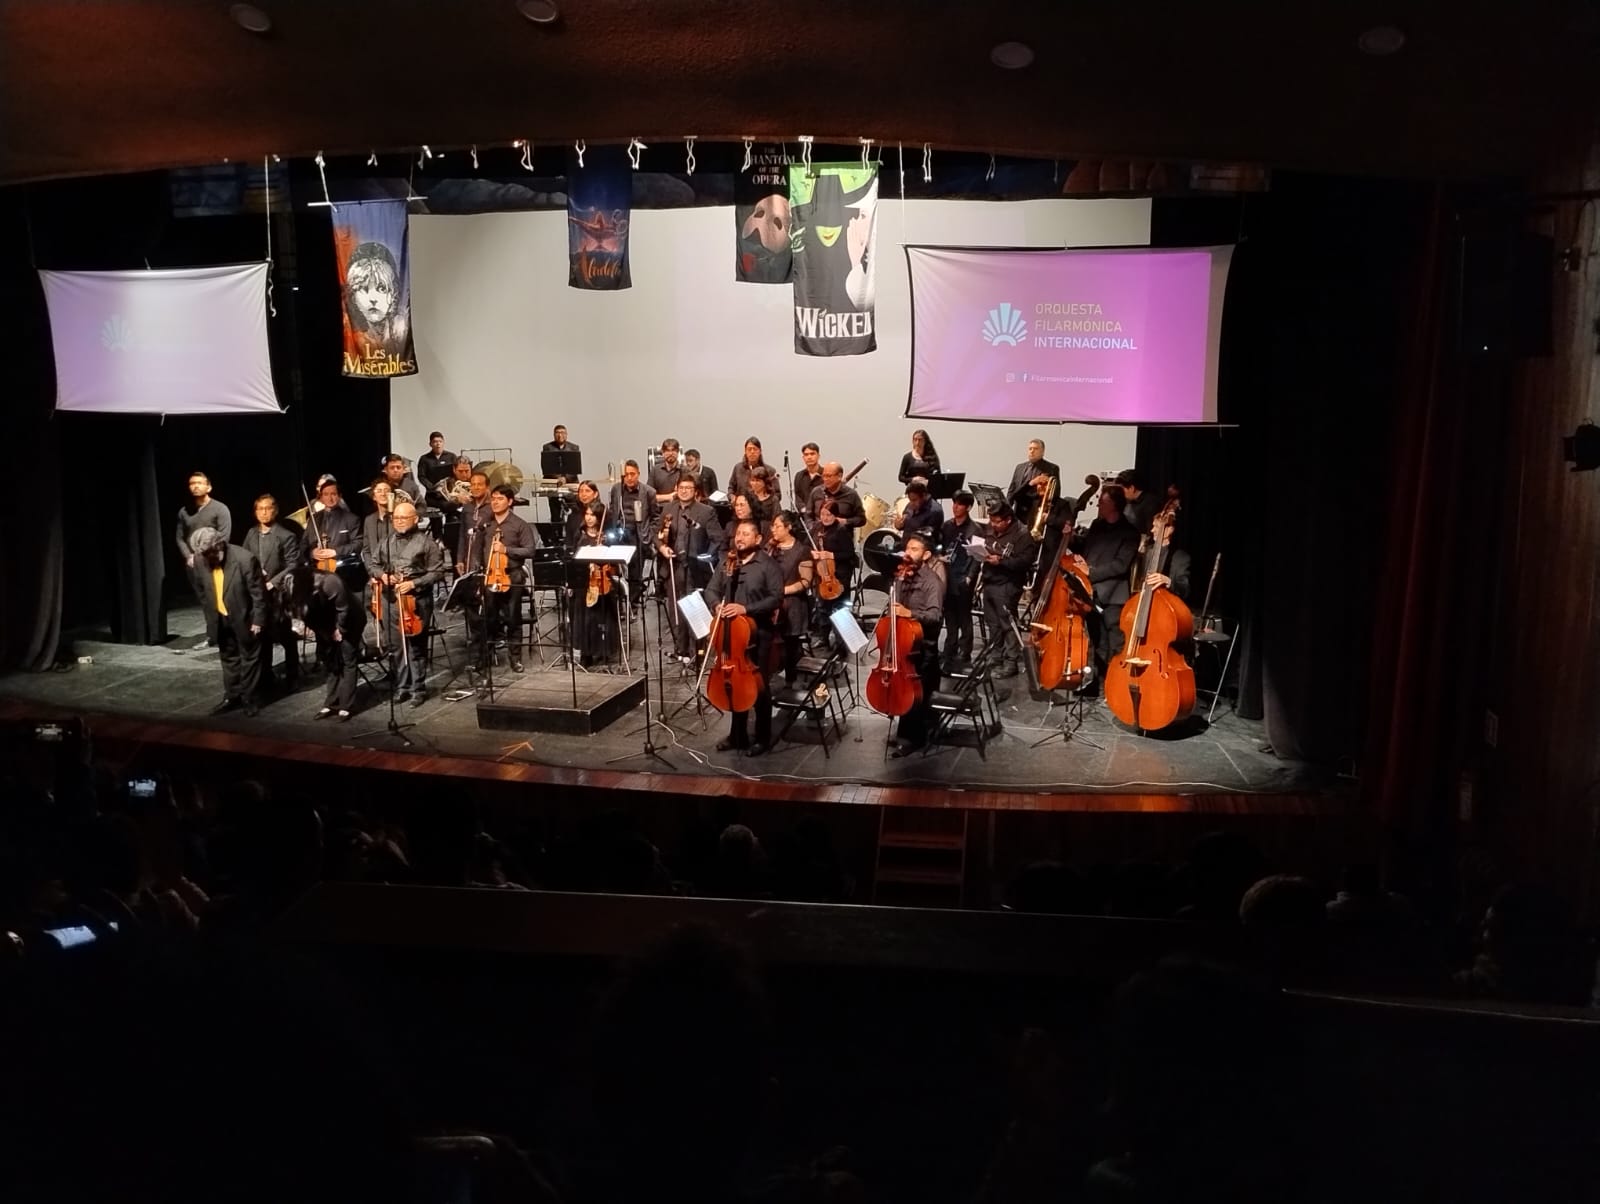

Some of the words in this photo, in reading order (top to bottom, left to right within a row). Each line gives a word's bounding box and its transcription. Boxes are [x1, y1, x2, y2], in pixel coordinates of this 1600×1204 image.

[744, 154, 796, 165] HANTOM
[752, 174, 787, 186] OPERA
[1035, 303, 1102, 315] ORQUESTA
[1034, 336, 1138, 350] INTERNACIONAL
[365, 343, 386, 359] Les
[343, 351, 416, 376] Misérables
